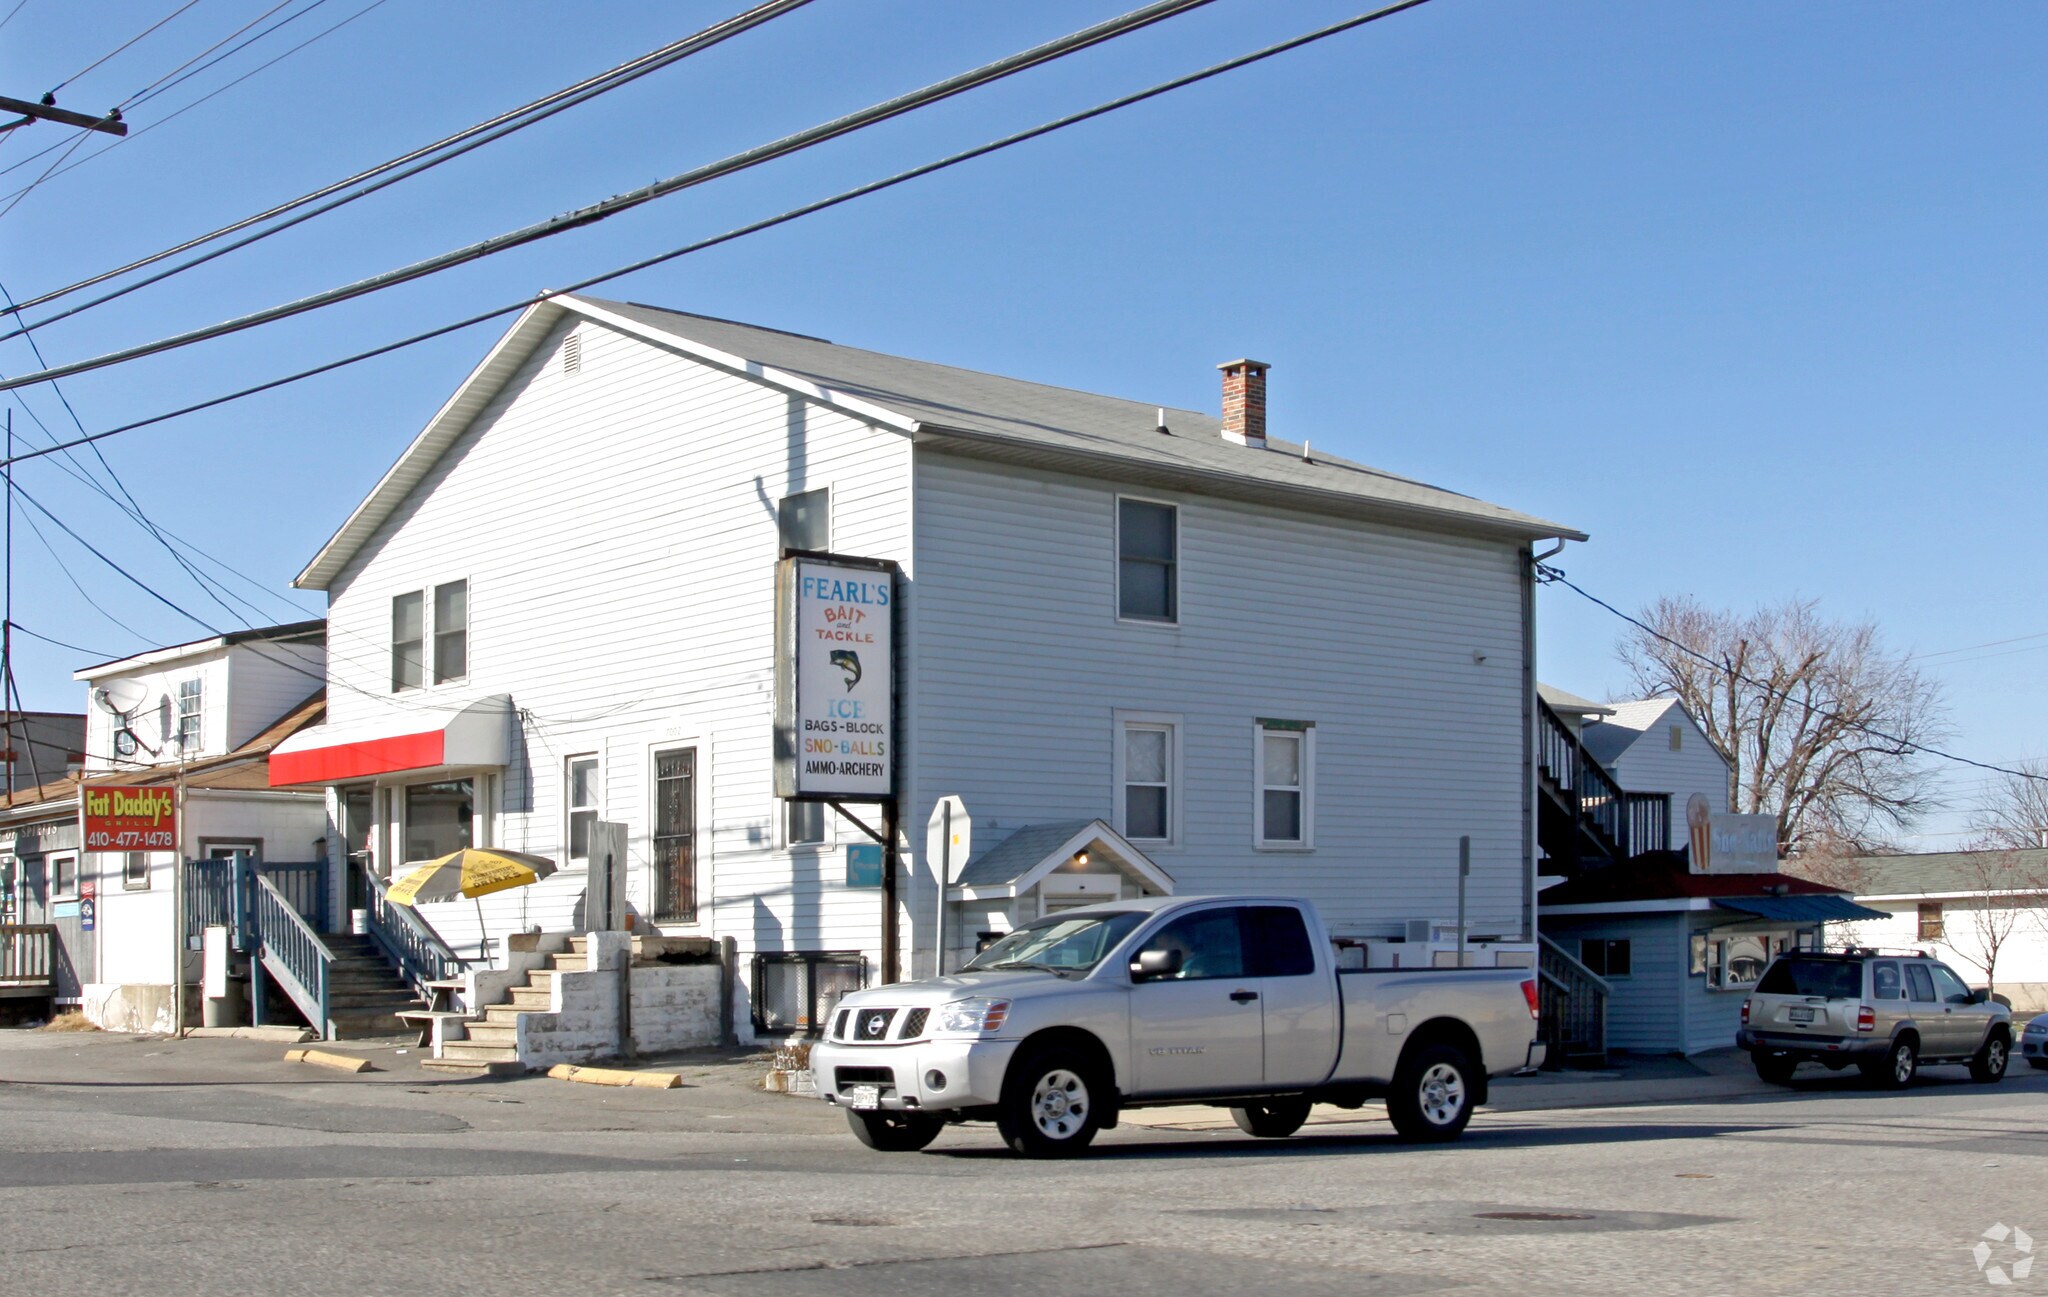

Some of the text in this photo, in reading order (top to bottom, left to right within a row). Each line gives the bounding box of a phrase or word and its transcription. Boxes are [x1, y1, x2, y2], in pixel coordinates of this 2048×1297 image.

[803, 576, 889, 606] FEARL'S
[824, 605, 866, 624] BAIT
[836, 620, 852, 630] and
[815, 629, 875, 644] TACKLE
[827, 698, 866, 719] ICE
[805, 738, 885, 756] SNO-BALLS
[86, 788, 173, 827] Fat Daddy's
[87, 831, 173, 847] 410-477-1478
